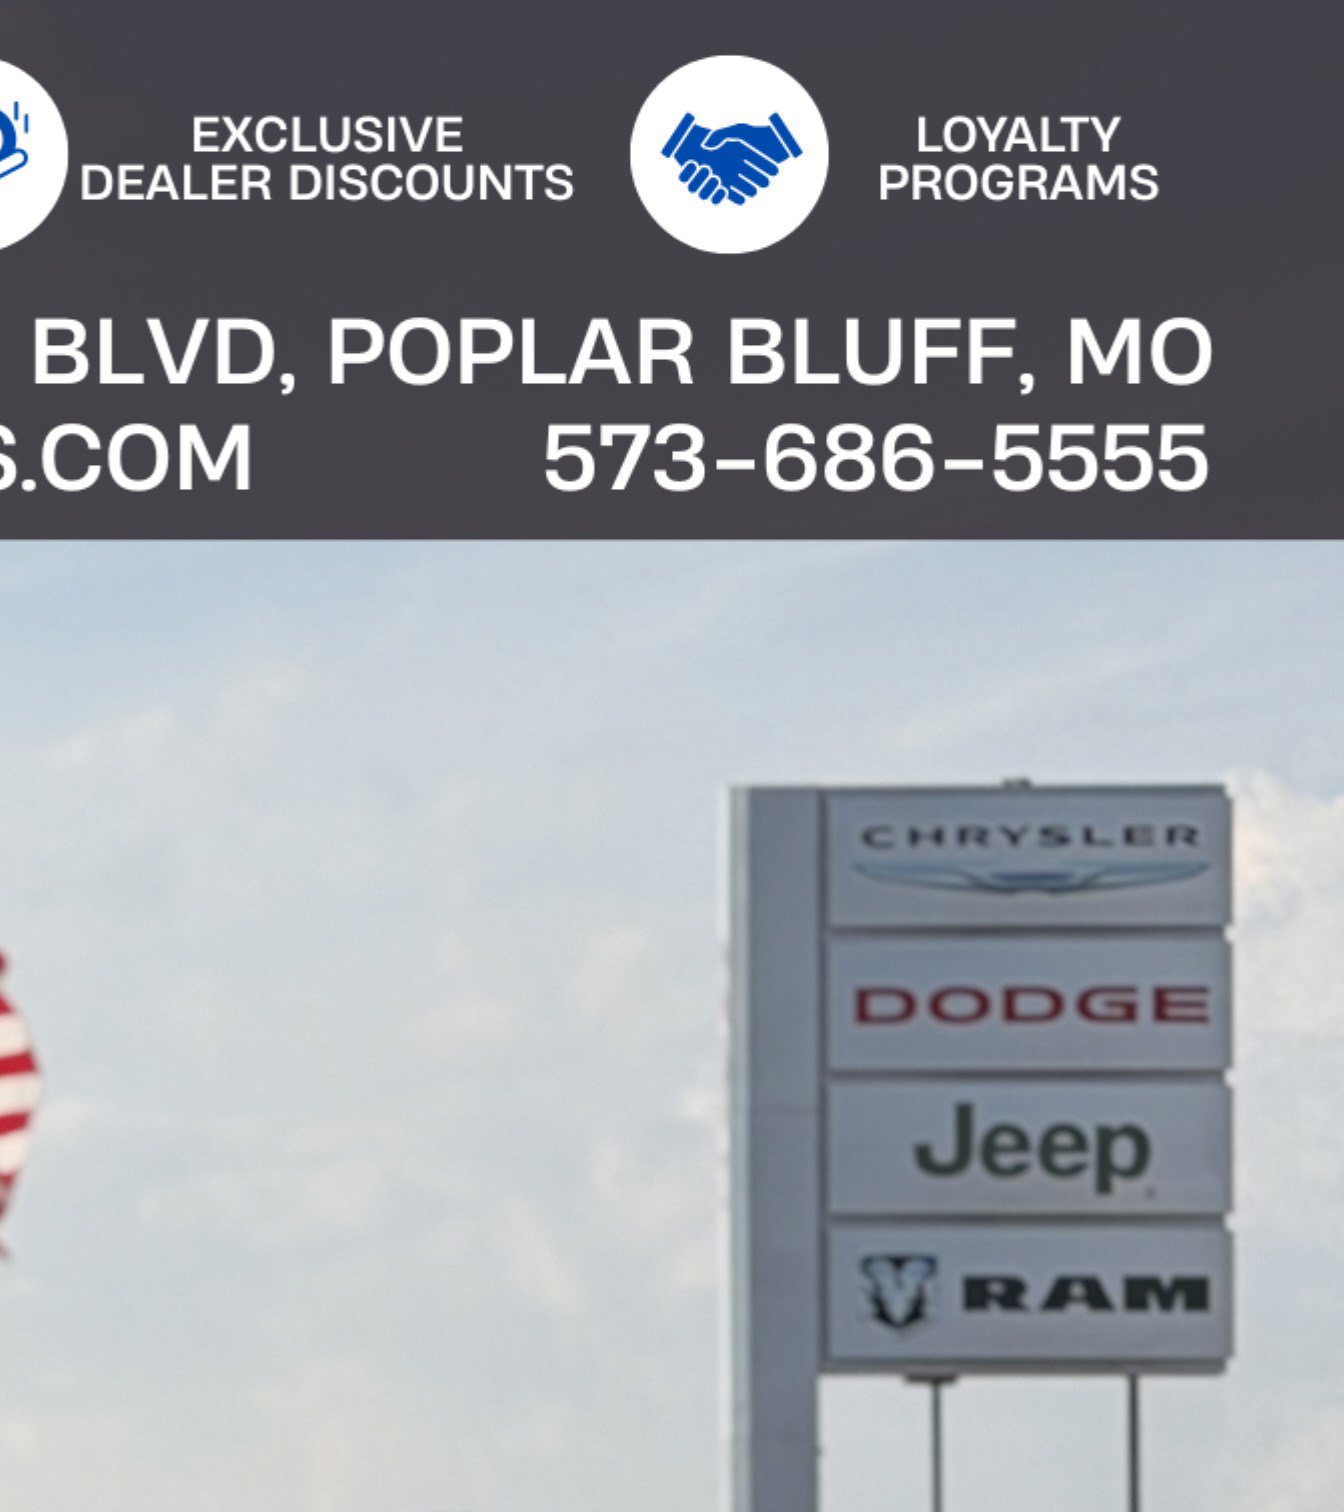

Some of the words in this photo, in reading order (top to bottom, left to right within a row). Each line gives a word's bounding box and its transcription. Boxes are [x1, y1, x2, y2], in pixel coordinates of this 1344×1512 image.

[860, 825, 1201, 850] CHRYSLER
[854, 986, 1211, 1025] DODGE
[913, 1102, 1153, 1195] Jeep
[961, 1275, 1211, 1313] RAM
